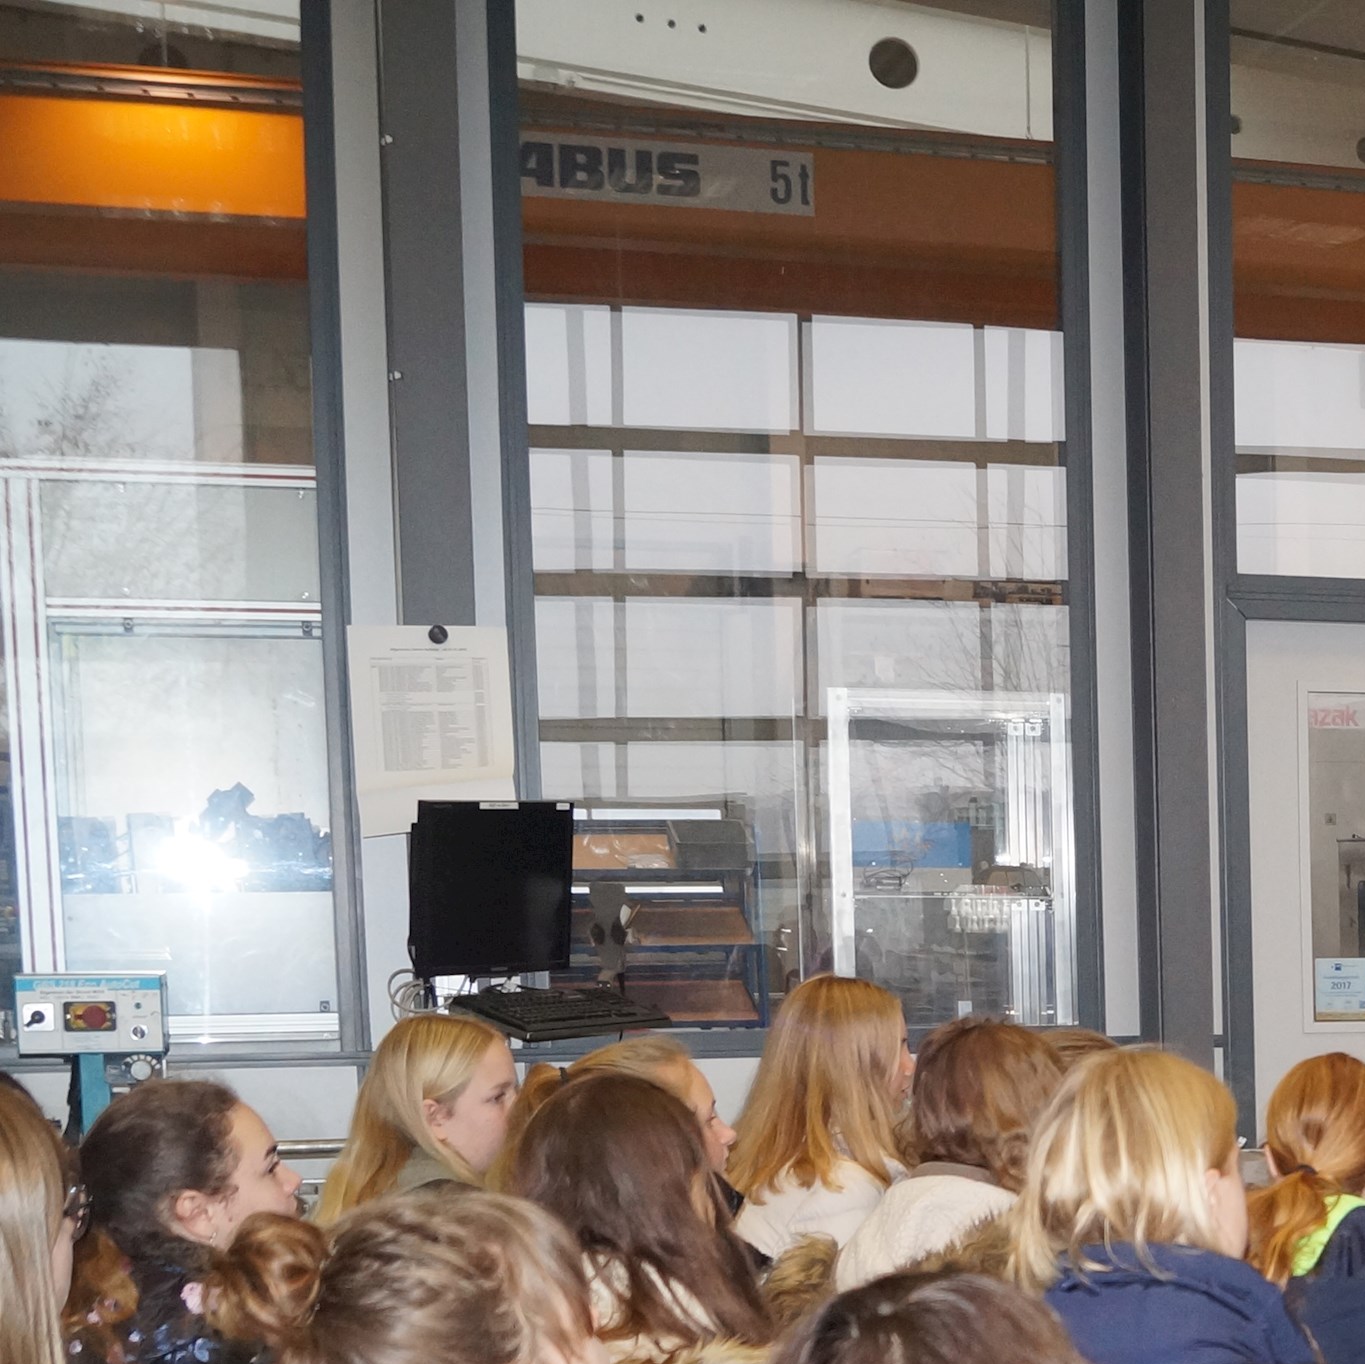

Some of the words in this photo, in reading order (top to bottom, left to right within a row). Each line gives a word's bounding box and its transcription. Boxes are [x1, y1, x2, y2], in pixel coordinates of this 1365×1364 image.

[520, 142, 700, 197] ABUS
[770, 159, 811, 206] 5t
[1330, 981, 1352, 990] 2017
